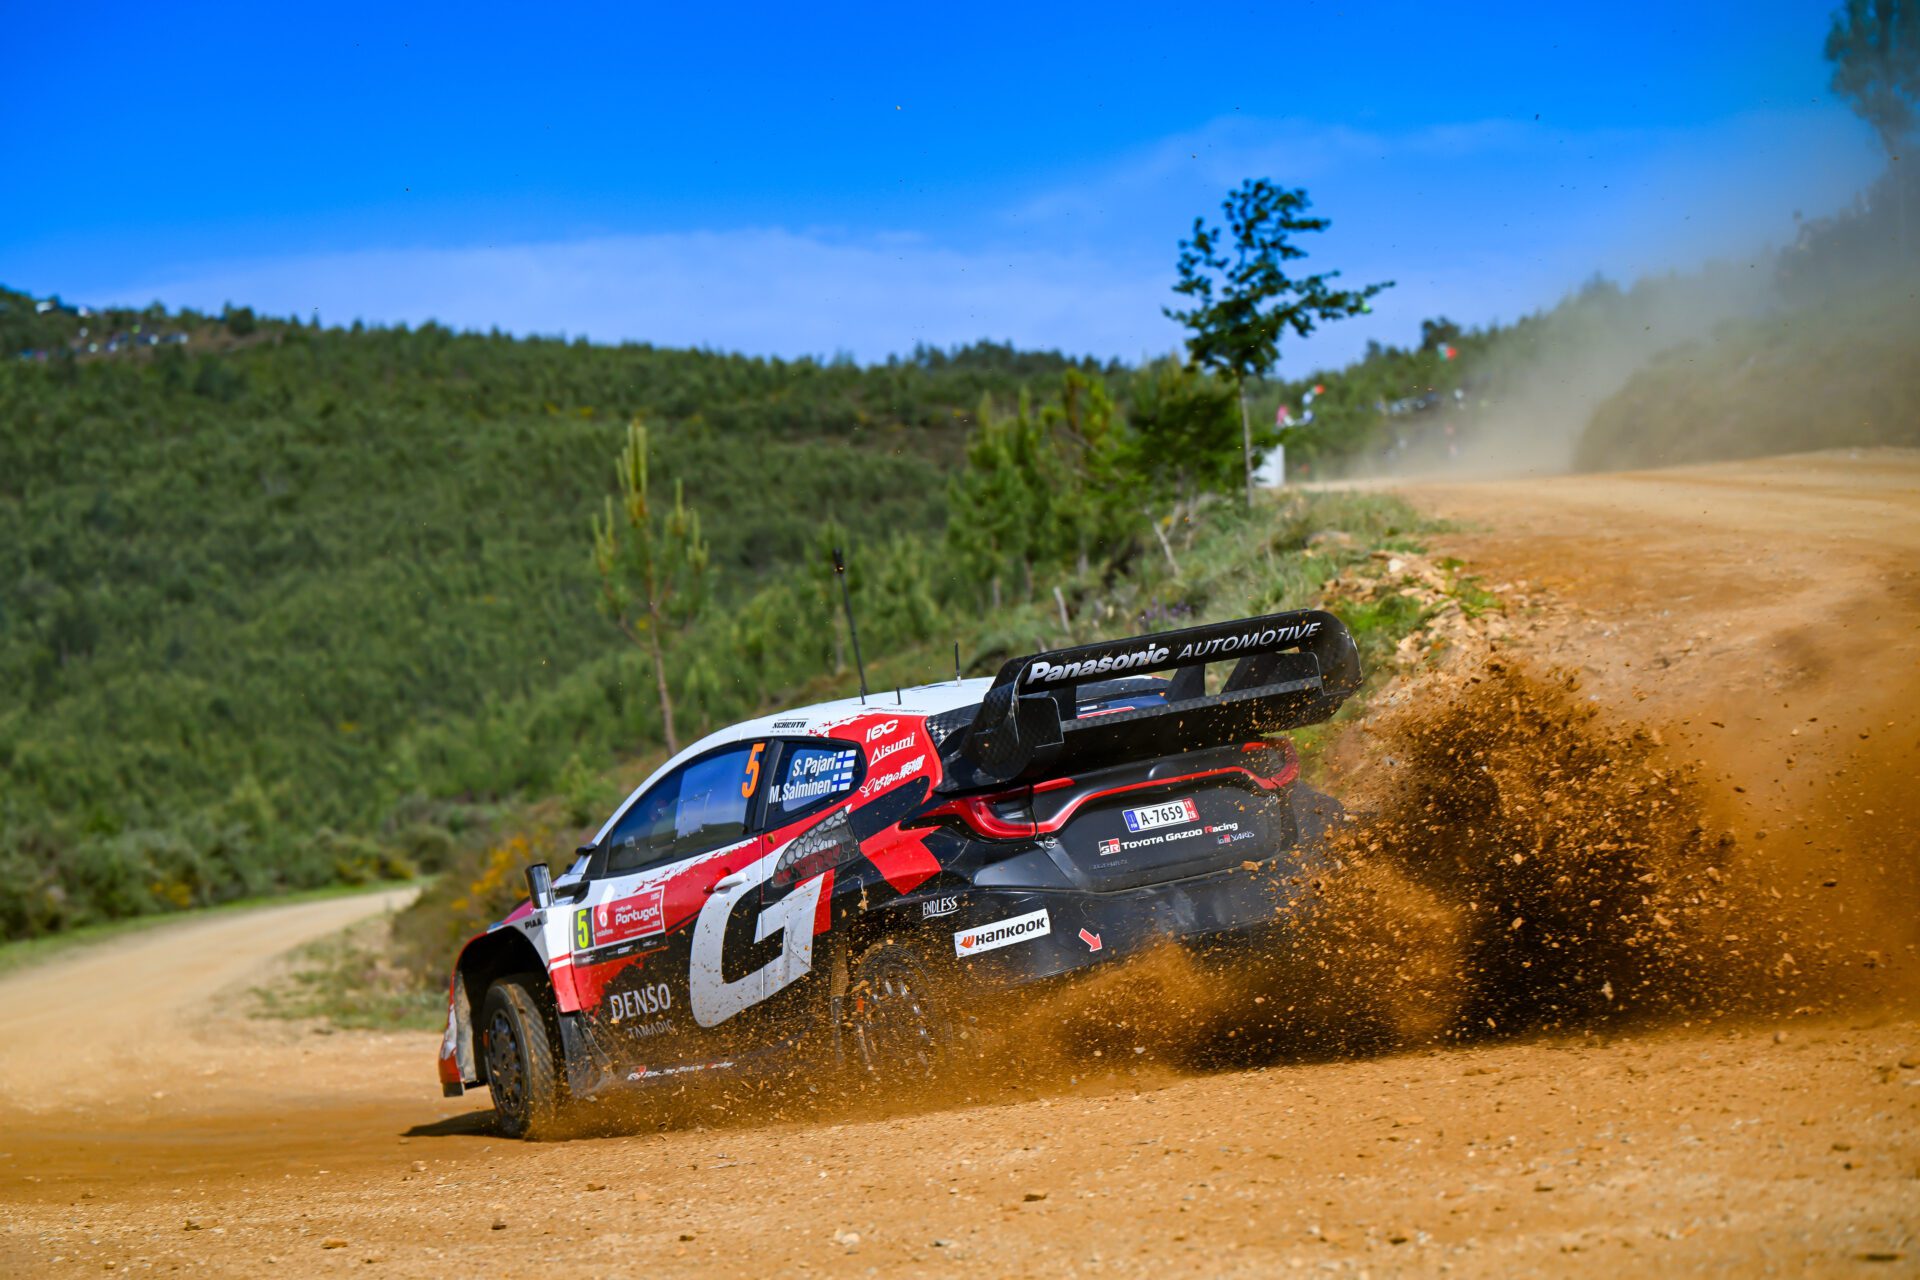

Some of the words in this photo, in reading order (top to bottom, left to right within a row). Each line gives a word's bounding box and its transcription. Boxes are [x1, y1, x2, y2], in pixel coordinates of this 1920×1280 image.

[1025, 644, 1169, 685] Panasonic
[1176, 622, 1322, 660] AUTOMOTIVE
[869, 732, 915, 767] Aisumi
[741, 743, 766, 799] 5
[793, 753, 836, 777] S.Pajari
[769, 779, 831, 803] M.Salminen
[1140, 804, 1184, 826] A-7659
[1121, 836, 1164, 850] TOYOTA
[1165, 829, 1203, 842] GAZOO
[1204, 822, 1238, 834] Racing
[615, 904, 660, 926] Portugal
[922, 895, 958, 916] ENDLESS
[524, 918, 542, 930] PIAA
[577, 909, 589, 949] 5
[610, 983, 671, 1021] DENSO
